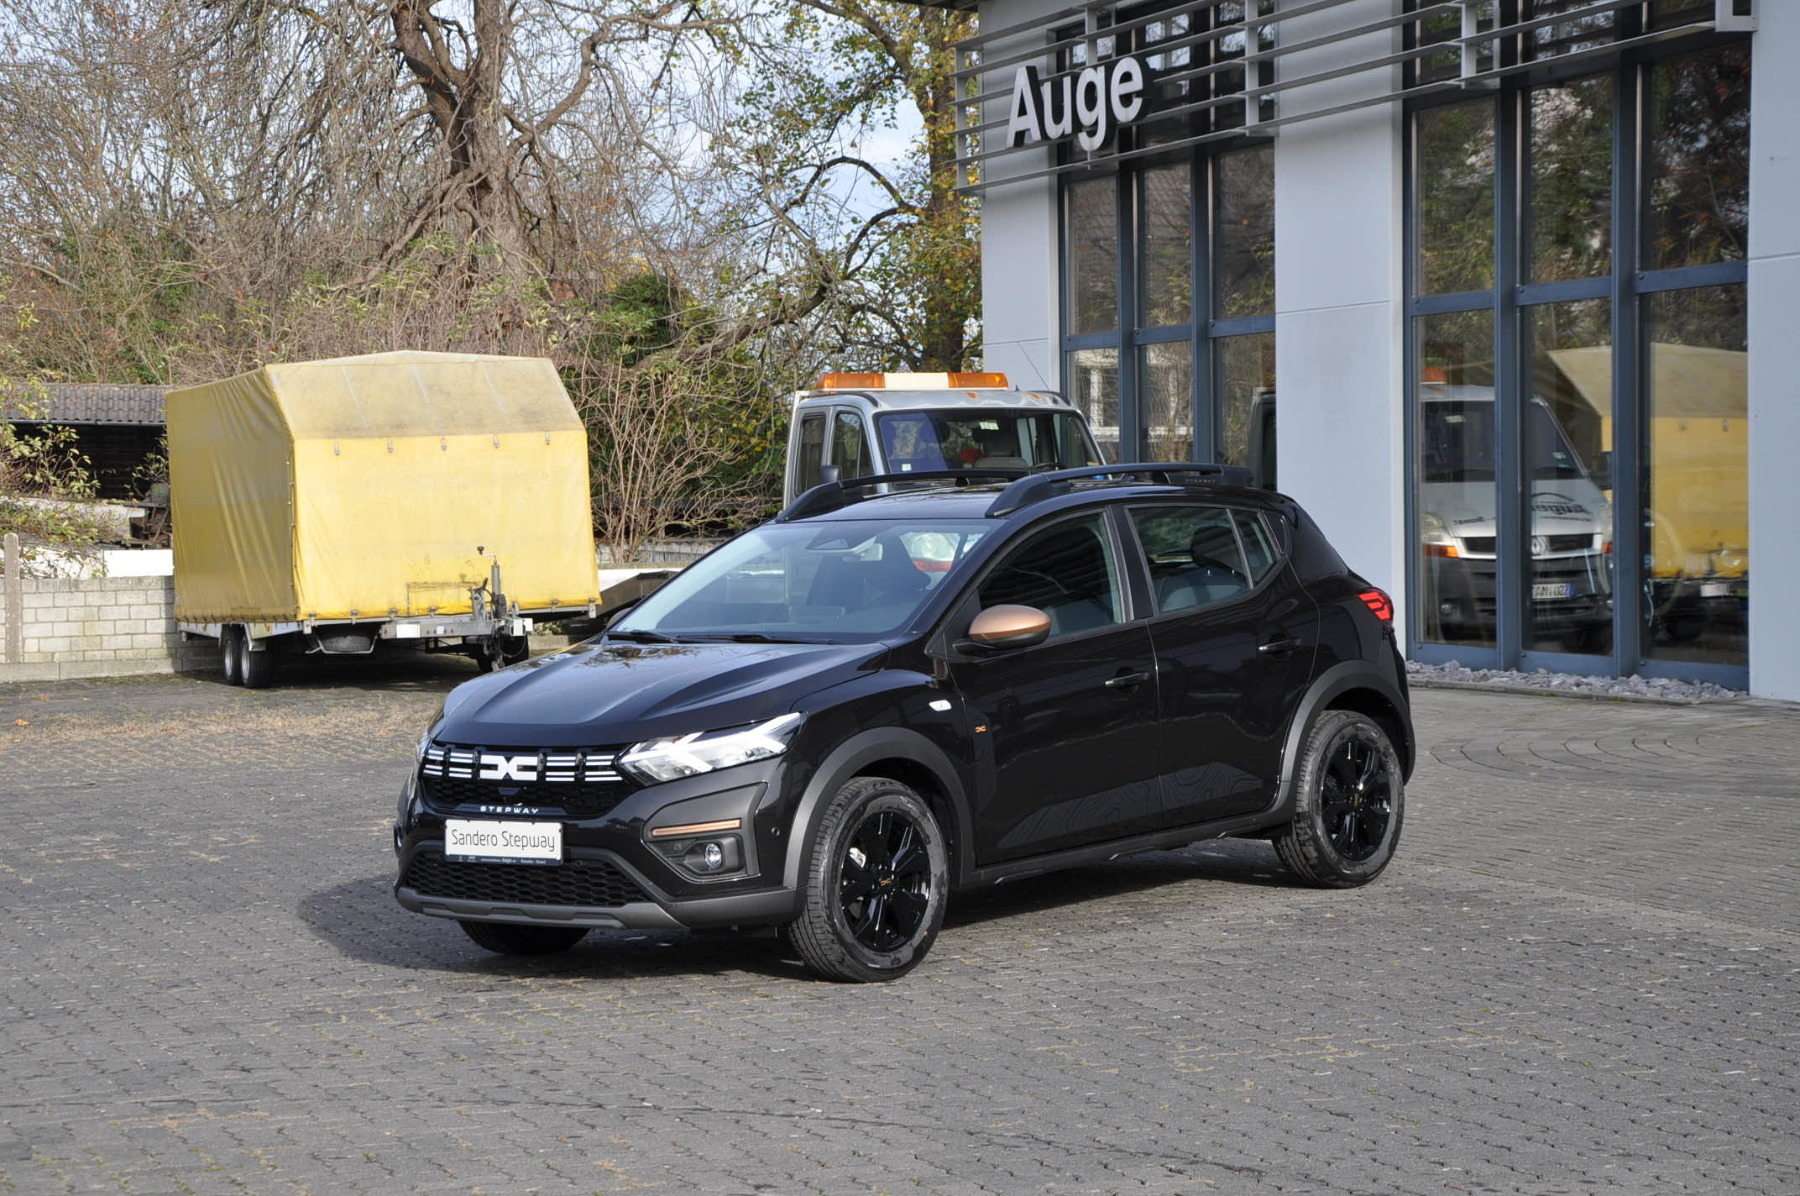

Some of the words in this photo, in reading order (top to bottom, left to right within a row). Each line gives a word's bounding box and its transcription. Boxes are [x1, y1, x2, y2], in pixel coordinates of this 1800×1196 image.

[1006, 57, 1144, 151] Auge
[480, 805, 539, 814] STEPWAY
[451, 829, 498, 847] Sandero
[501, 830, 555, 852] Stepway
